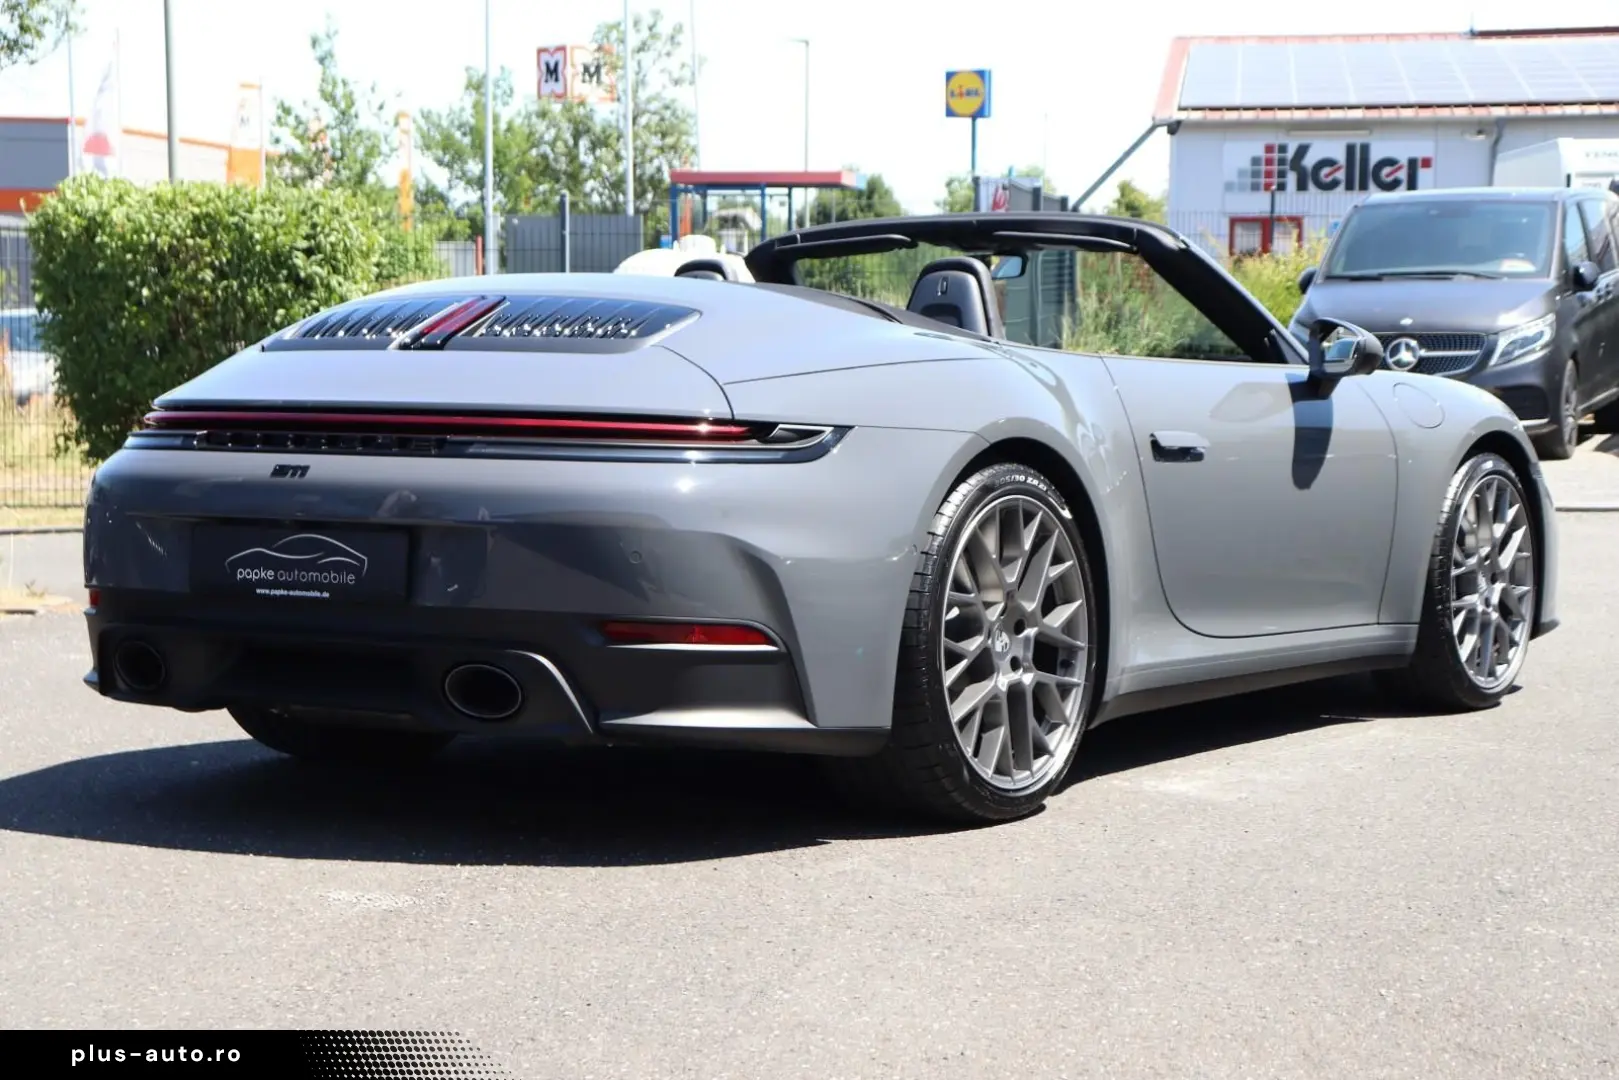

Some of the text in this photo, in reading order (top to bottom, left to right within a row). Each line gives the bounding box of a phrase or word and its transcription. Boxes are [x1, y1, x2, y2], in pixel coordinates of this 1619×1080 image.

[544, 60, 560, 83] M
[581, 62, 602, 84] M
[1276, 141, 1433, 191] Keller
[236, 566, 356, 585] papke automobile
